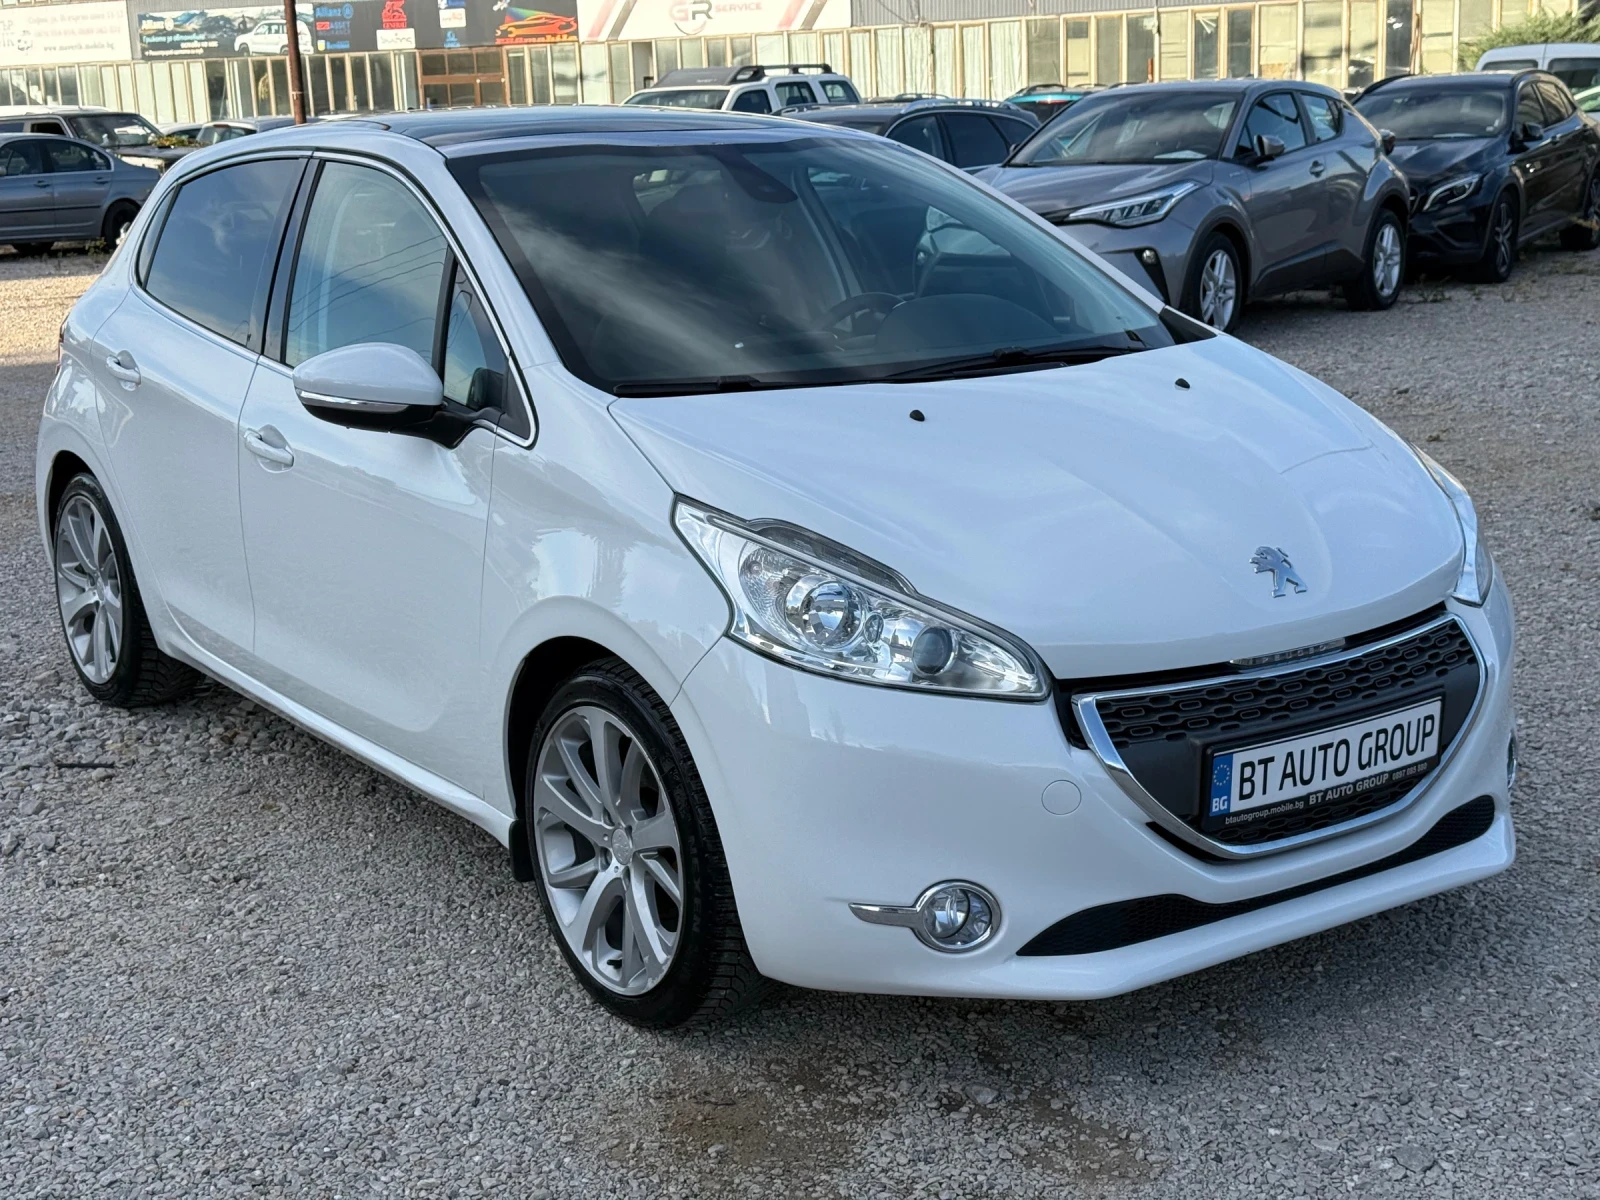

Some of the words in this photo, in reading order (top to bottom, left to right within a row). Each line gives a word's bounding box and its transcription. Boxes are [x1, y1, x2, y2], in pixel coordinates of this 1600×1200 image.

[715, 2, 762, 13] SERVICE
[1238, 755, 1275, 801] BT
[1279, 738, 1350, 791] AUTO
[1357, 714, 1435, 771] GROUP
[1211, 795, 1229, 812] BG
[1225, 800, 1304, 825] btautogroup.mobile.bg
[1309, 791, 1323, 805] BT
[1325, 785, 1354, 802] AUTO
[1356, 773, 1389, 793] GROUP
